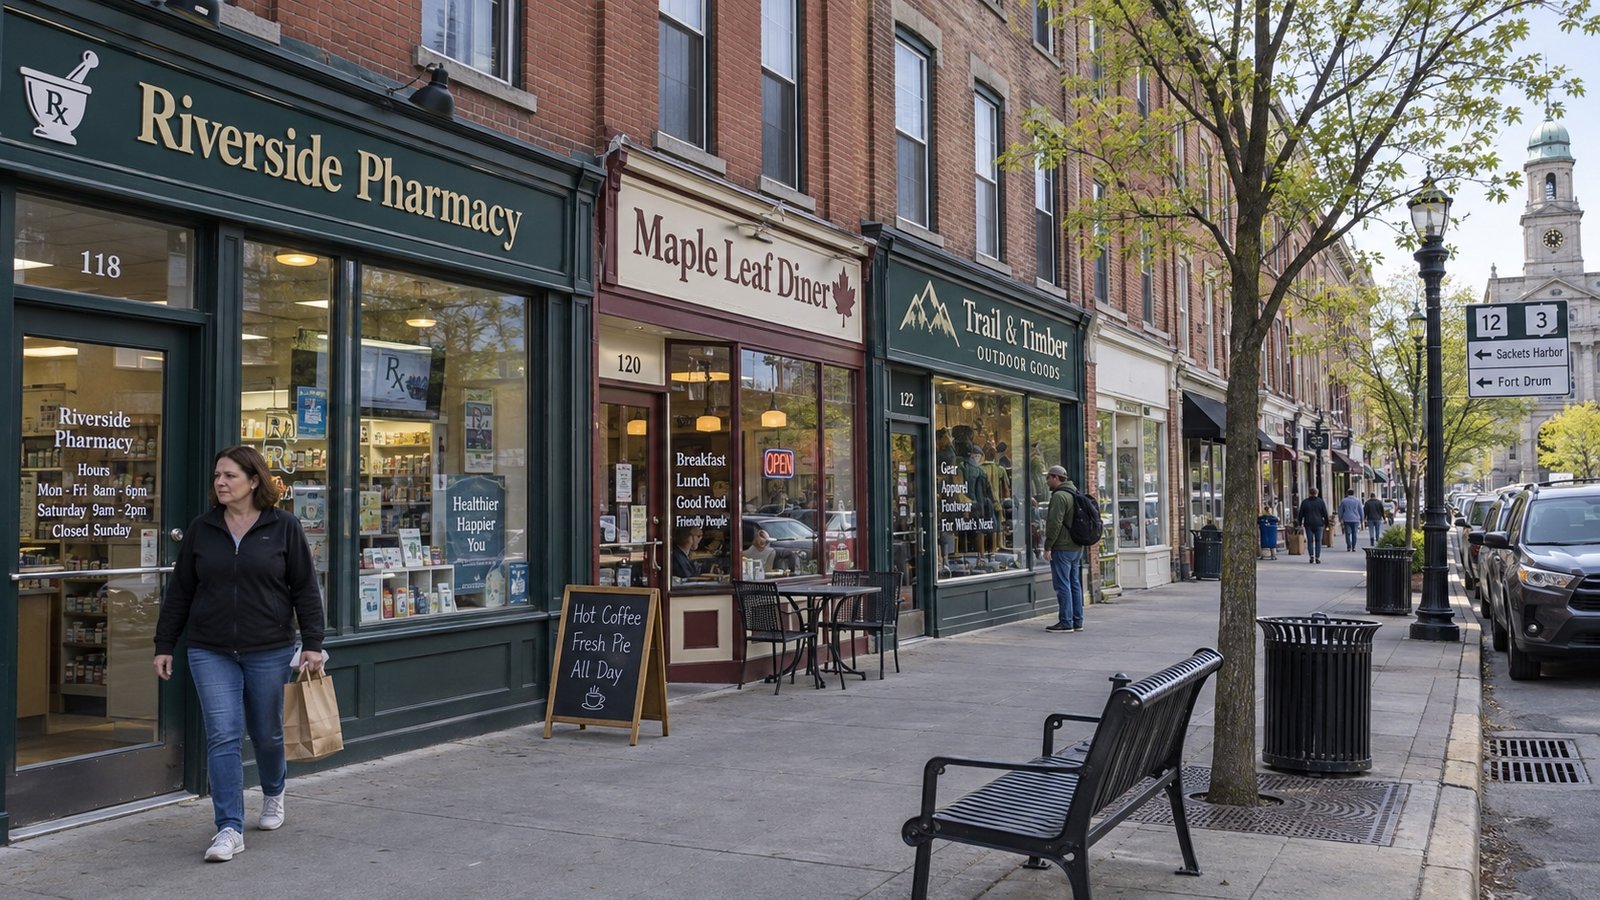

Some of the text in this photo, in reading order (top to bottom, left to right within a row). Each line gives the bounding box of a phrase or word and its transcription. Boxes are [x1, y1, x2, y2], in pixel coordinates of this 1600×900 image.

[45, 88, 70, 127] Rx
[136, 82, 523, 251] Riverside Pharmacy
[80, 250, 122, 280] 118
[632, 207, 831, 310] Maple Leaf Diner
[1481, 313, 1501, 331] 12
[1536, 311, 1548, 329] 3
[963, 298, 1068, 361] Trail & Timber
[1496, 346, 1564, 360] Sackets Harbor
[617, 353, 641, 375] 120
[977, 345, 1060, 380] OUTDOOR GOODS
[385, 356, 405, 393] Rx
[1498, 375, 1552, 388] Fort Drum
[899, 391, 915, 408] 122
[59, 406, 131, 428] Riverside
[54, 429, 134, 454] Pharmacy
[676, 451, 727, 467] Breakfast
[765, 452, 793, 475] OPEN
[78, 463, 111, 477] Hours
[941, 461, 958, 475] Gear
[676, 472, 710, 487] Lunch
[37, 483, 63, 497] Mon
[73, 483, 88, 497] Fri
[93, 483, 116, 497] 8am
[125, 484, 148, 500] 6pm
[941, 480, 968, 497] Apparel
[453, 495, 499, 512] Healthier
[676, 494, 727, 509] Good Food
[941, 499, 973, 513] Footwear
[37, 503, 87, 519] Saturday
[92, 503, 115, 517] 9am
[124, 503, 147, 519] 2pm
[457, 516, 496, 535] Happier
[676, 514, 728, 529] Friendly People
[941, 517, 994, 532] For What's Next
[52, 523, 132, 539] Closed Sunday
[467, 538, 486, 552] You
[573, 603, 642, 626] Hot Coffee
[572, 631, 631, 653] Fresh Pie
[570, 659, 623, 687] All Day
